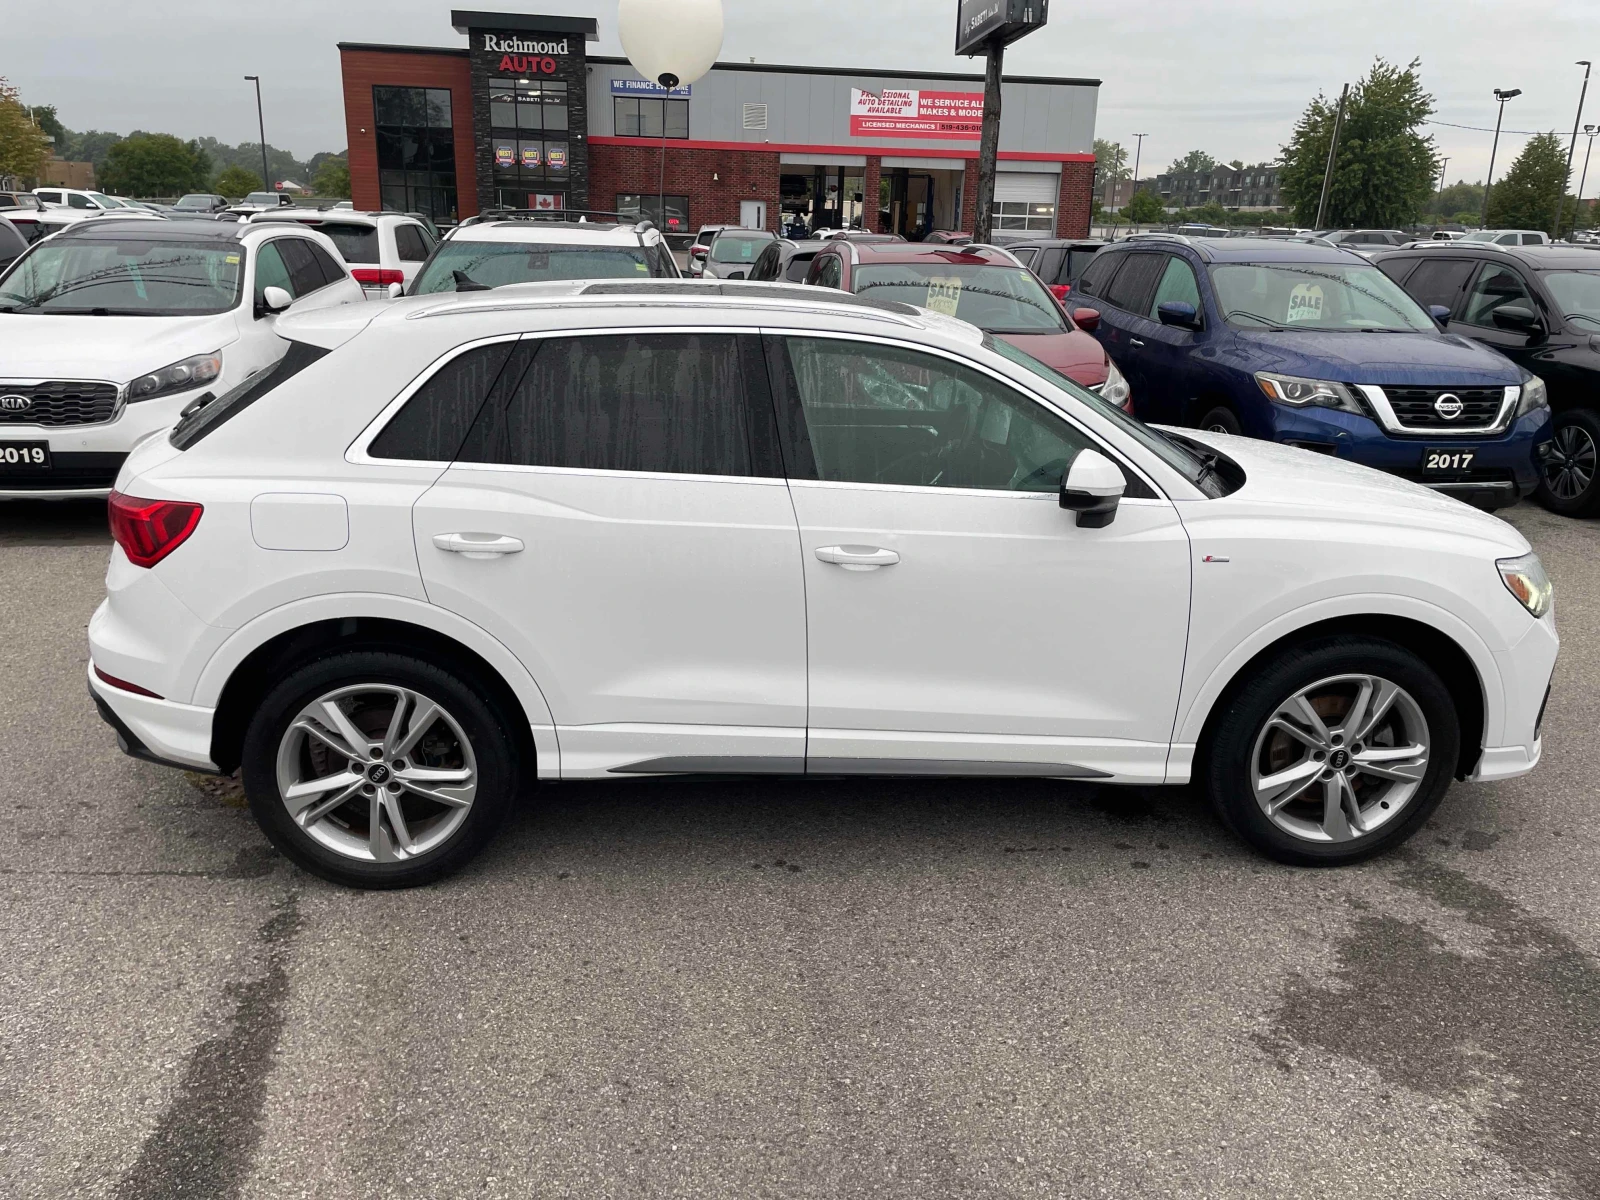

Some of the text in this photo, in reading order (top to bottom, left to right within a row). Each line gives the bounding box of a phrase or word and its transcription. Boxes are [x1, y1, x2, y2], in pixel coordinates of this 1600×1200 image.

[484, 33, 569, 54] Richmond
[499, 55, 556, 74] AUTO
[613, 80, 624, 88] WE
[626, 81, 654, 90] FINANCE
[861, 90, 910, 99] PROSSIONAL
[877, 99, 912, 107] DETAILING
[920, 98, 933, 106] WE
[934, 99, 969, 107] SERVICE
[867, 106, 903, 114] AVAILABLE
[919, 107, 983, 117] MAKES & MODE
[928, 286, 959, 300] SALE
[1290, 295, 1321, 310] SALE
[1, 399, 25, 409] KIA
[1427, 454, 1473, 468] 2017
